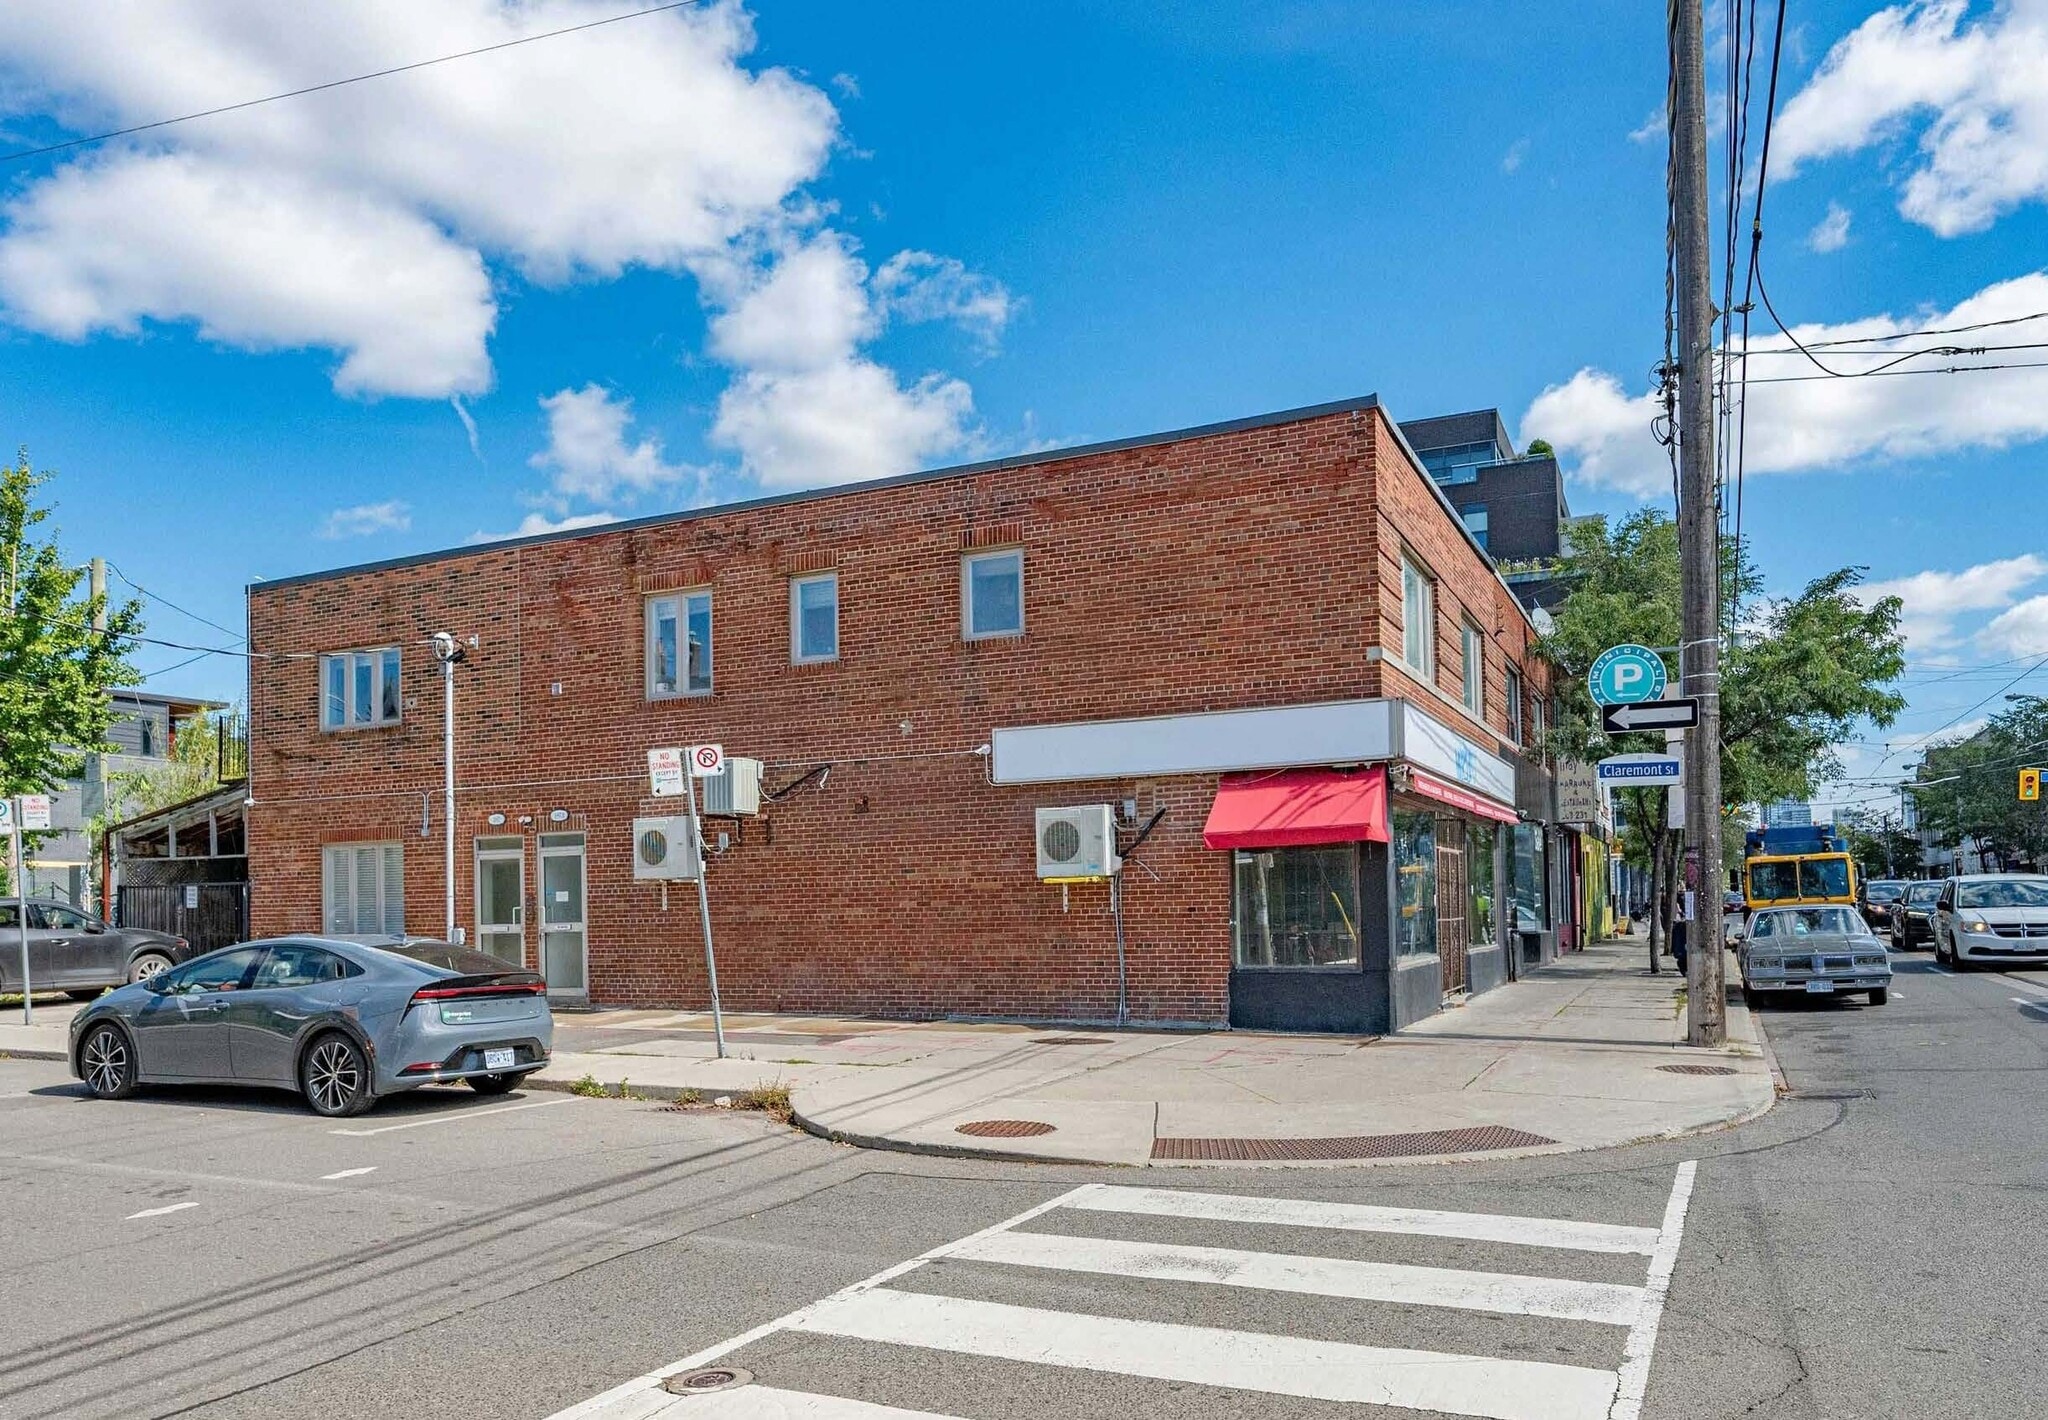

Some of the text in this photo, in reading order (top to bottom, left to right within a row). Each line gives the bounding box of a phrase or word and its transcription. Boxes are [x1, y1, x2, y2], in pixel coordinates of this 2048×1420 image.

[1592, 647, 1661, 680] MUNICIPAL
[1614, 663, 1643, 691] P
[659, 752, 670, 760] NO
[651, 761, 680, 771] STANDING
[1604, 764, 1674, 777] Claremont St
